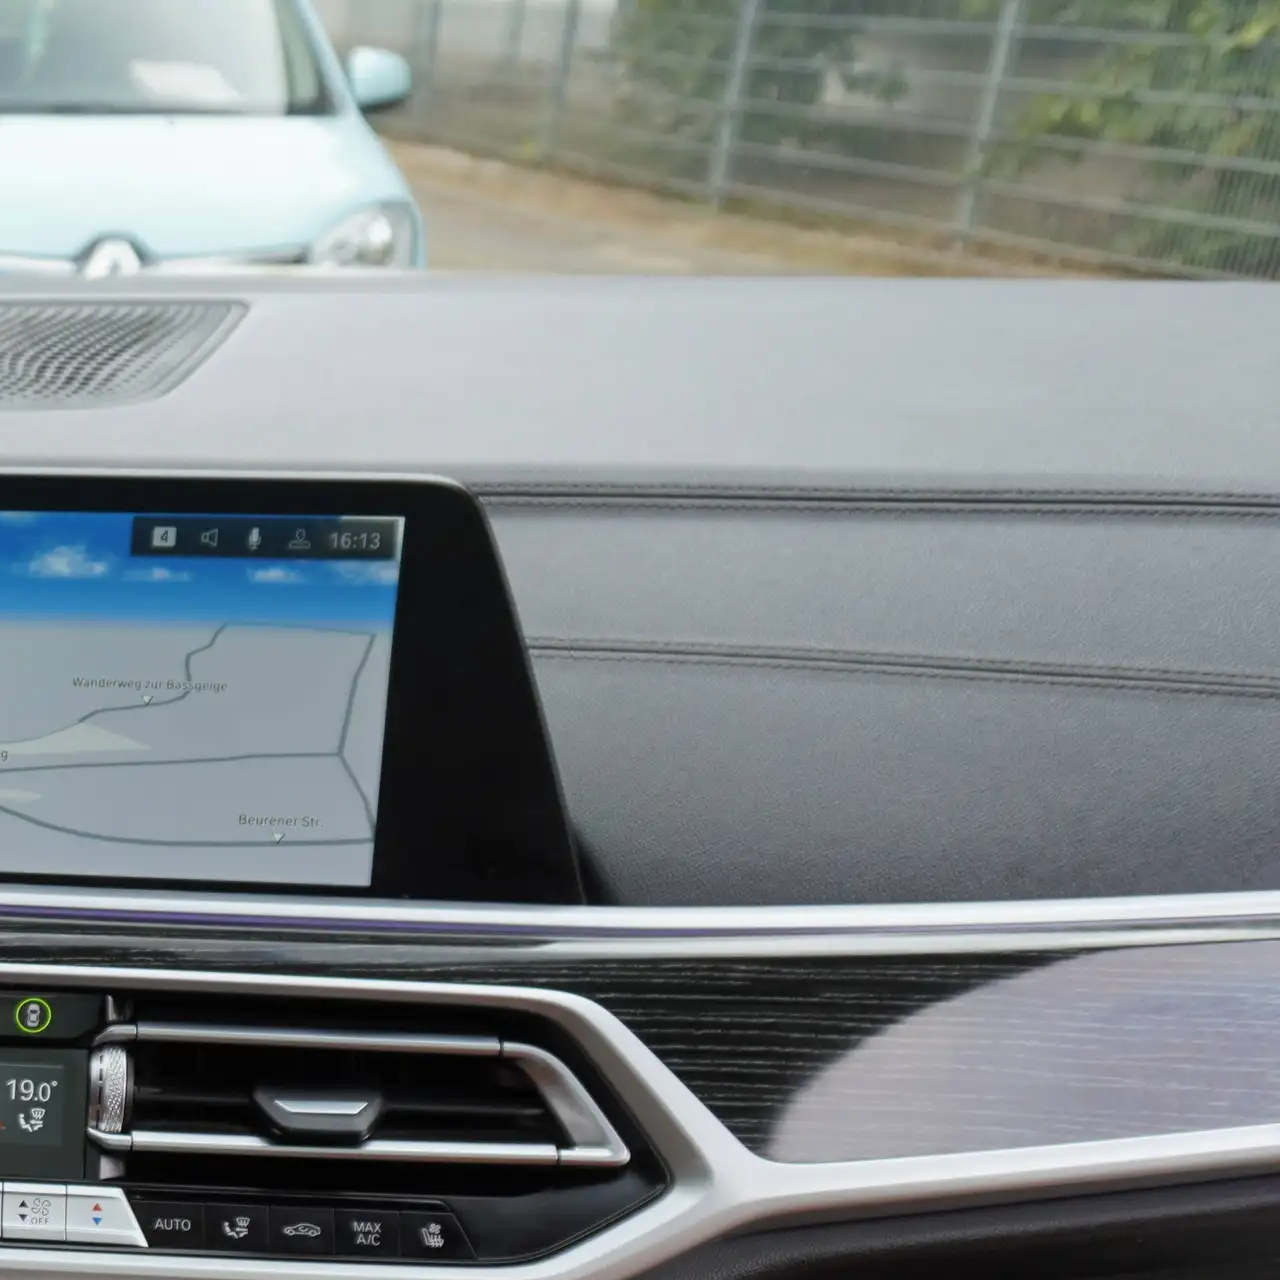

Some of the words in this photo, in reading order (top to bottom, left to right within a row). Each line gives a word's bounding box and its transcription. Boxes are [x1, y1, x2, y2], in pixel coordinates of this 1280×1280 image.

[330, 532, 381, 549] 16:13
[72, 677, 142, 691] Wanderweg
[144, 680, 162, 690] zur
[238, 814, 299, 827] Beurener
[30, 1217, 50, 1225] OFF
[154, 1218, 191, 1231] AUTO
[353, 1221, 382, 1233] MAX
[356, 1233, 380, 1246] A/C
